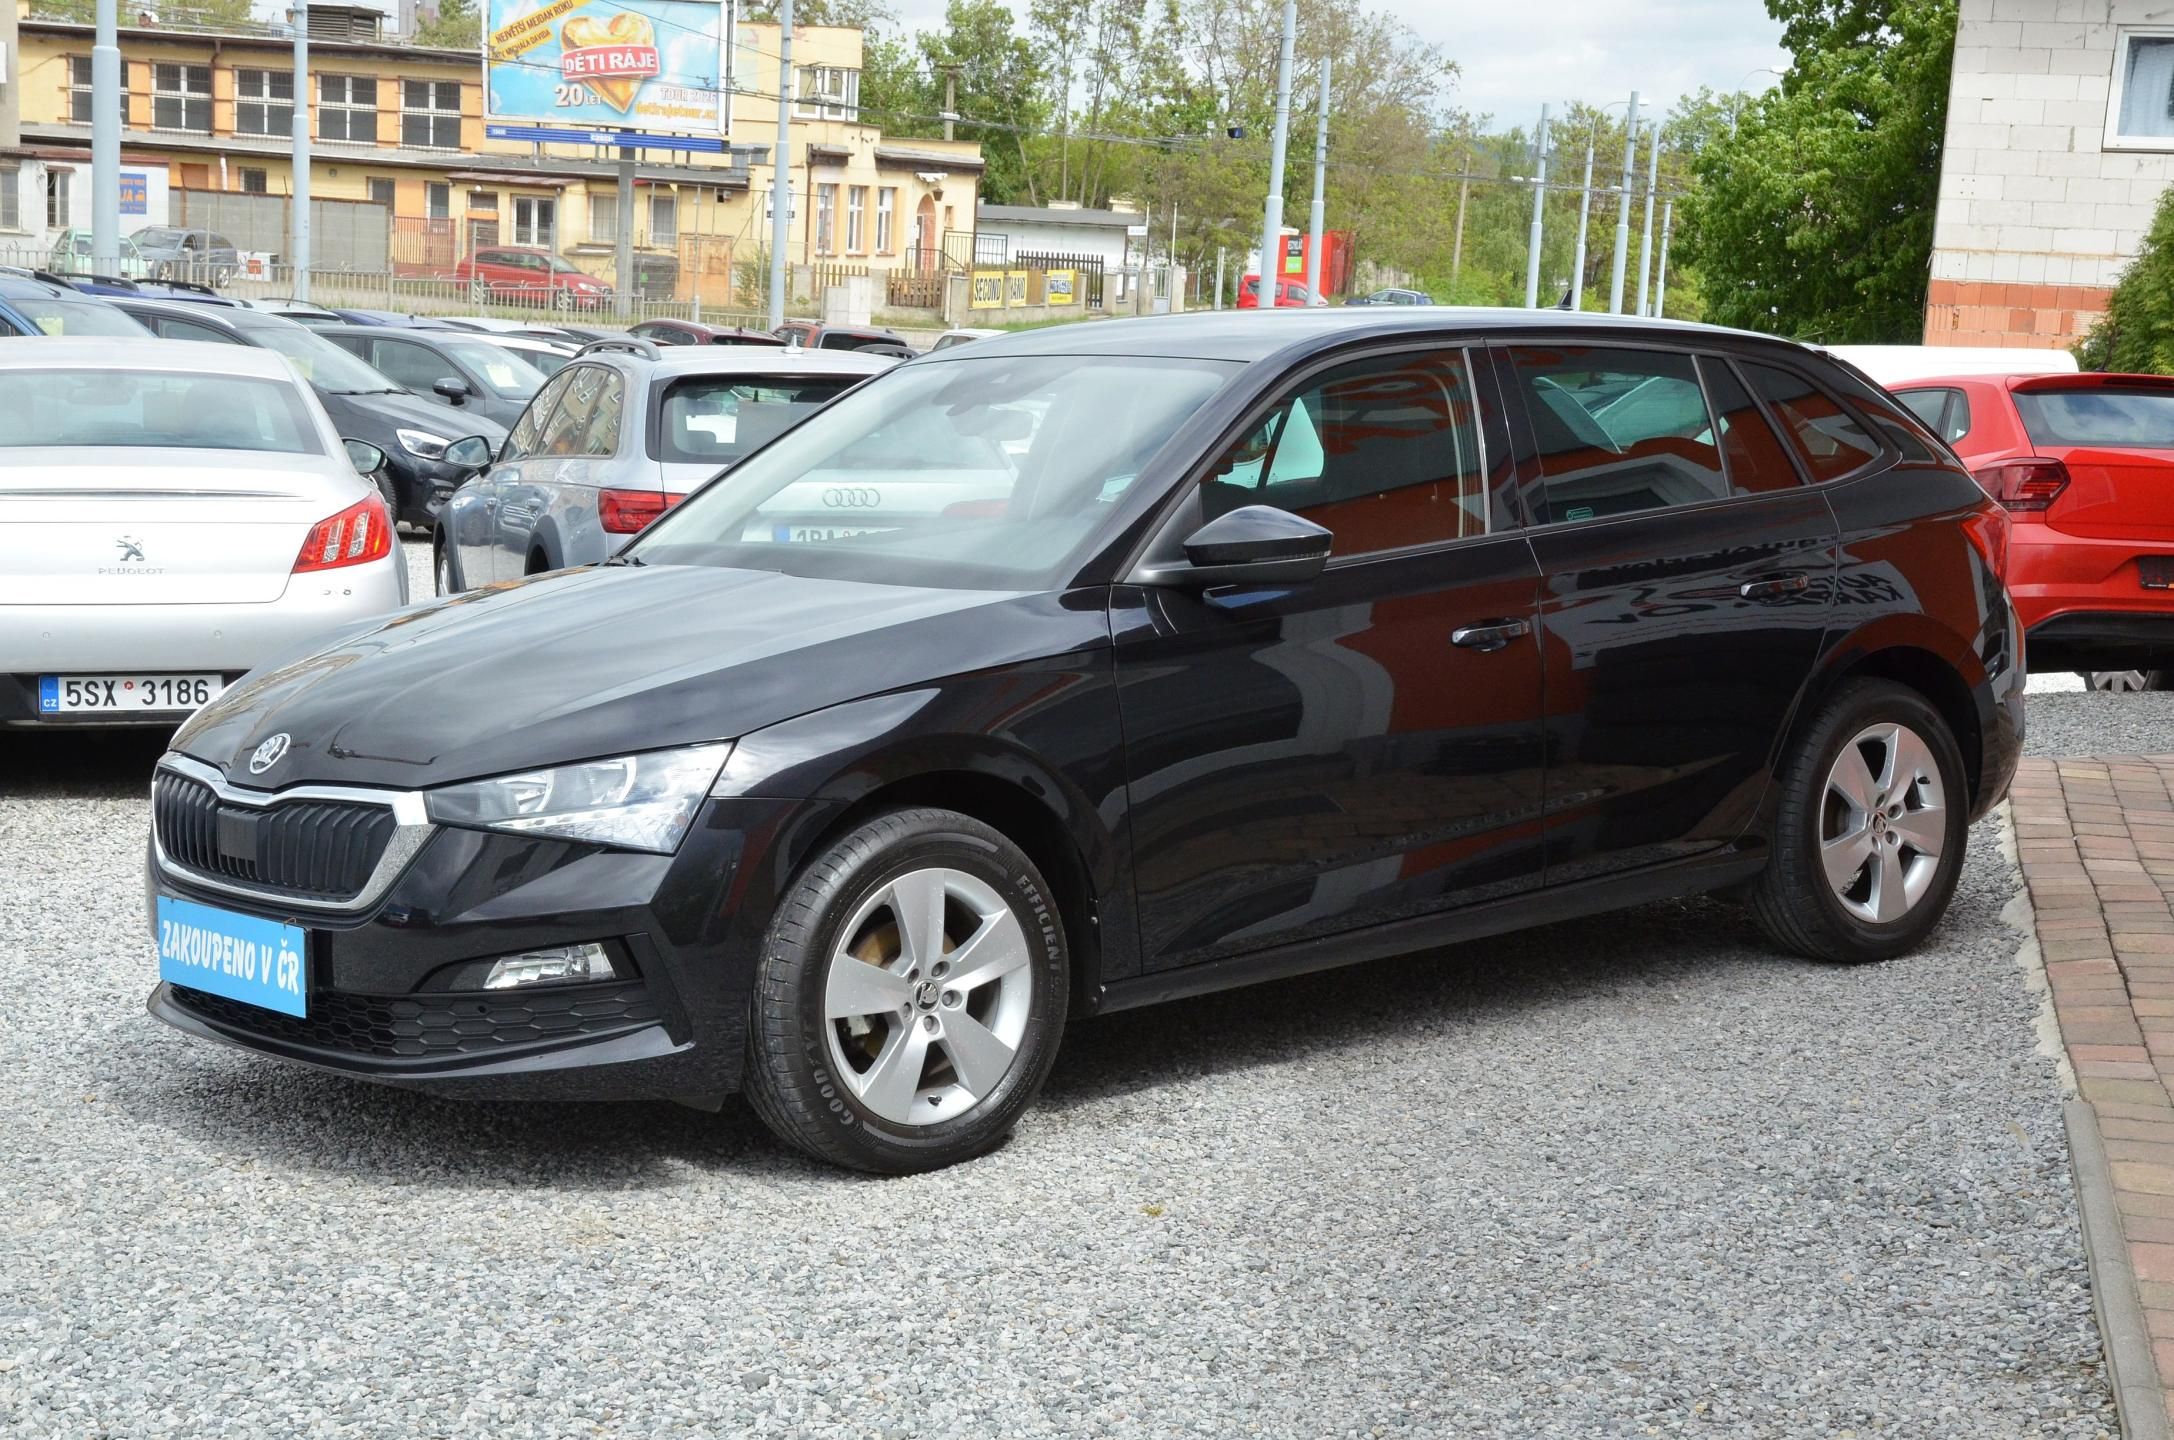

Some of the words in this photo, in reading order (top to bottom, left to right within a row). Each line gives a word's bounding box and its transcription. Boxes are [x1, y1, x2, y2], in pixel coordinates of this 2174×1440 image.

[526, 9, 554, 29] MEJDAN
[552, 0, 574, 16] ROKU
[565, 52, 606, 73] DĚTI
[609, 48, 656, 69] RÁJE
[554, 83, 584, 107] 20
[585, 95, 603, 106] LET
[974, 277, 1002, 302] SECOND
[98, 567, 166, 576] PEUGEOT
[43, 699, 57, 708] CZ
[66, 680, 117, 707] 5SX
[141, 679, 209, 706] 3186
[162, 919, 257, 982] ZAKOUPENO
[261, 944, 273, 985] V
[277, 938, 300, 996] ČR
